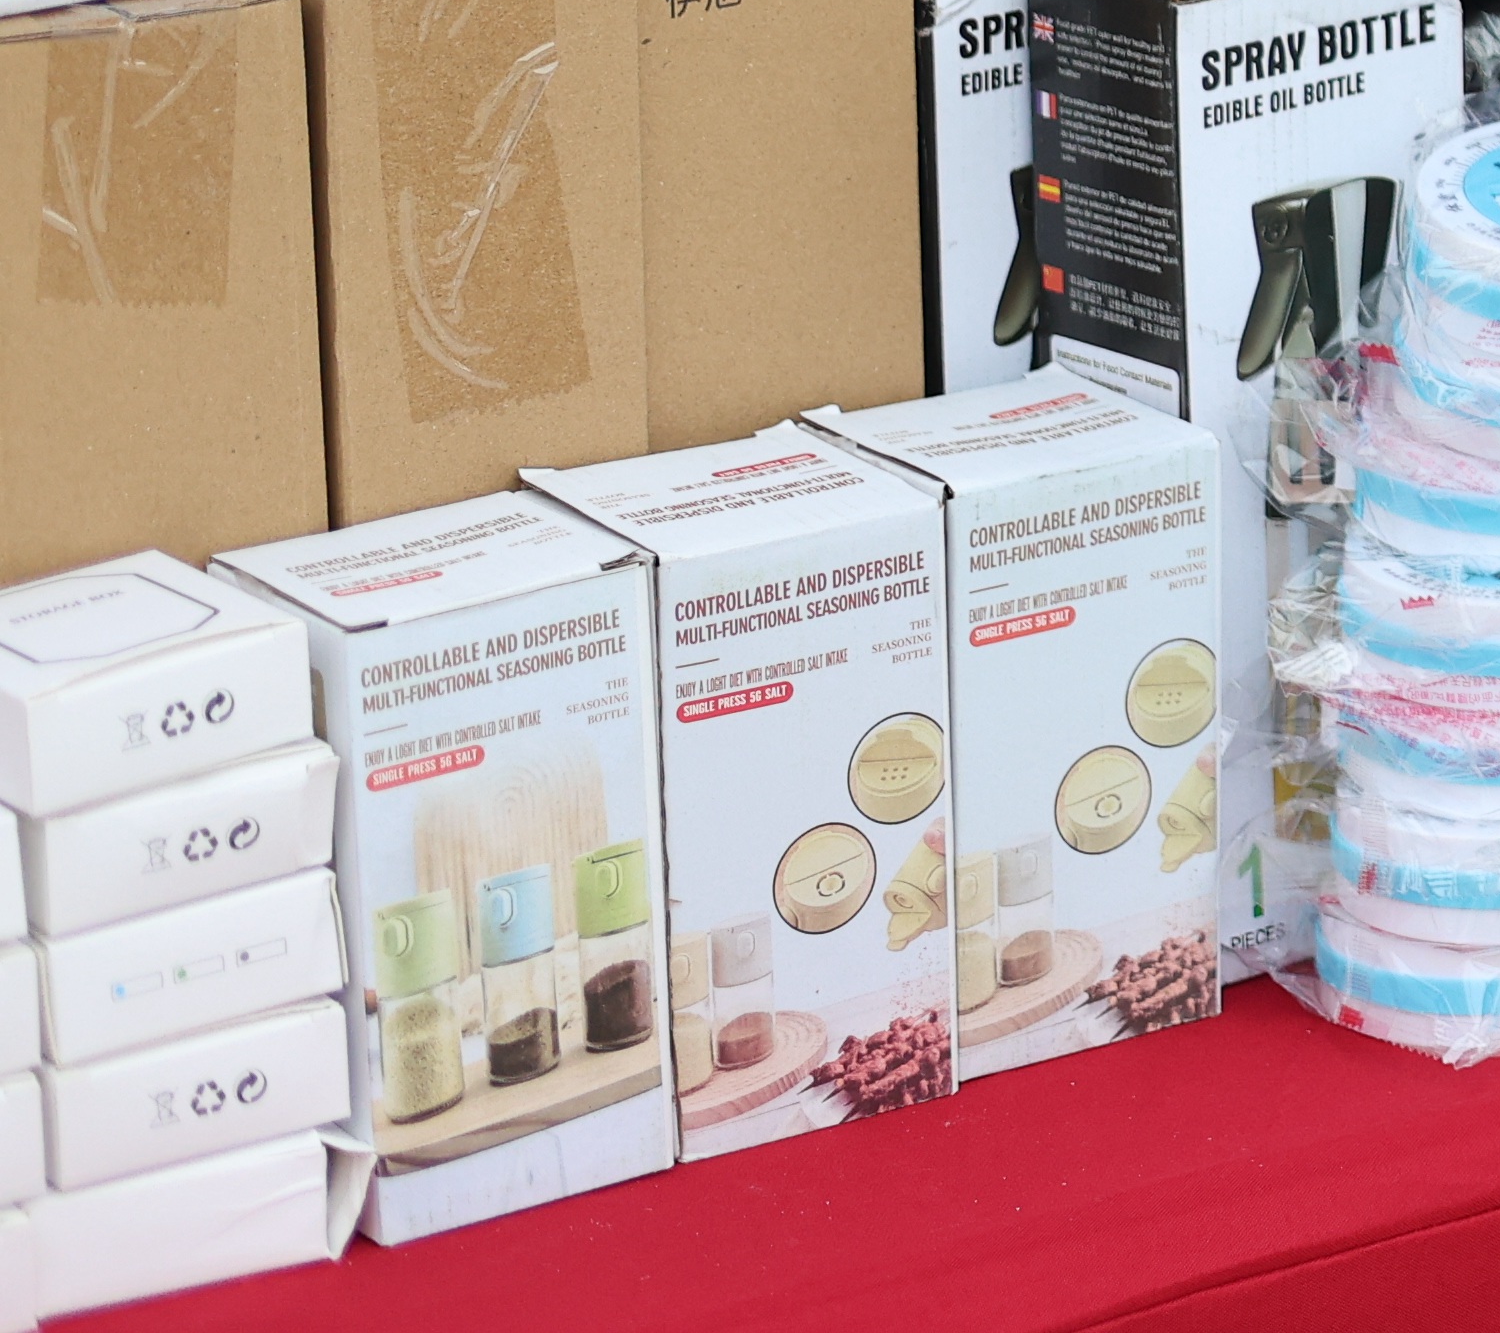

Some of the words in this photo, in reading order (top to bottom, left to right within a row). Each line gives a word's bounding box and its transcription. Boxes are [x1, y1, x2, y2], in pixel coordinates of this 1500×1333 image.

[1201, 30, 1306, 91] SPRAY
[1318, 3, 1436, 65] BOTTLE
[961, 63, 1023, 97] EDIBLE
[1204, 95, 1264, 129] EDIBLE
[1270, 87, 1297, 113] OIL
[1304, 71, 1365, 106] BOTTLE
[664, 494, 735, 512] SEASONING
[728, 499, 756, 510] AND
[763, 477, 864, 504] CONTROLLABLE
[614, 507, 661, 520] BOTTLE
[632, 505, 724, 526] DISPERSIBLE
[970, 508, 1076, 548] CONTROLLABLE
[1081, 502, 1110, 524] AND
[1115, 481, 1201, 517] DISPERSIBLE
[286, 545, 398, 573] CONTROLLABLE
[402, 537, 432, 551] AND
[436, 512, 528, 542] DISPERSIBLE
[421, 530, 495, 555] SEASONING
[498, 516, 544, 532] BOTTLE
[970, 535, 1086, 572] MULTI-FUNCTIONAL
[1090, 517, 1158, 546] SEASONING
[1163, 506, 1206, 530] BOTTLE
[1186, 547, 1207, 559] THE
[675, 580, 791, 622] CONTROLLABLE
[796, 573, 827, 596] AND
[833, 551, 925, 589] DISPERSIBLE
[1150, 561, 1207, 580] SEASONING
[1169, 576, 1207, 591] BOTTLE
[676, 605, 803, 647] MULTI-FUNCTIONAL
[807, 586, 880, 619] SEASONING
[884, 577, 930, 602] BOTTLE
[910, 618, 931, 631] THE
[975, 624, 1004, 641] SINGLE
[1006, 618, 1032, 634] PRESS
[1036, 614, 1047, 627] 5G
[1050, 609, 1071, 624] SALT
[361, 642, 480, 688] CONTROLLABLE
[486, 634, 518, 658] AND
[524, 608, 620, 649] DISPERSIBLE
[872, 633, 932, 654] SEASONING
[892, 647, 932, 664] BOTTLE
[362, 668, 492, 714] MULTI-FUNCTIONAL
[497, 647, 573, 682] SEASONING
[578, 635, 626, 662] BOTTLE
[606, 677, 628, 690] THE
[676, 682, 696, 699] ENJOY
[700, 680, 703, 694] A
[730, 671, 743, 687] DIET
[747, 665, 763, 683] WITH
[765, 658, 805, 680] CONTROLLED
[808, 654, 823, 671] SALT
[826, 648, 848, 667] INTAKE
[566, 692, 629, 715] SEASONING
[588, 707, 630, 725] BOTTLE
[683, 701, 714, 717] SINGLE
[718, 694, 746, 710] PRESS
[750, 690, 761, 703] 5G
[765, 685, 787, 700] SALT
[373, 767, 404, 786] SINGLE
[408, 759, 437, 777] PRESS
[440, 755, 452, 769] 5G
[455, 749, 477, 765] SALT
[1237, 842, 1264, 918] 1
[1231, 922, 1287, 949] PIECES
